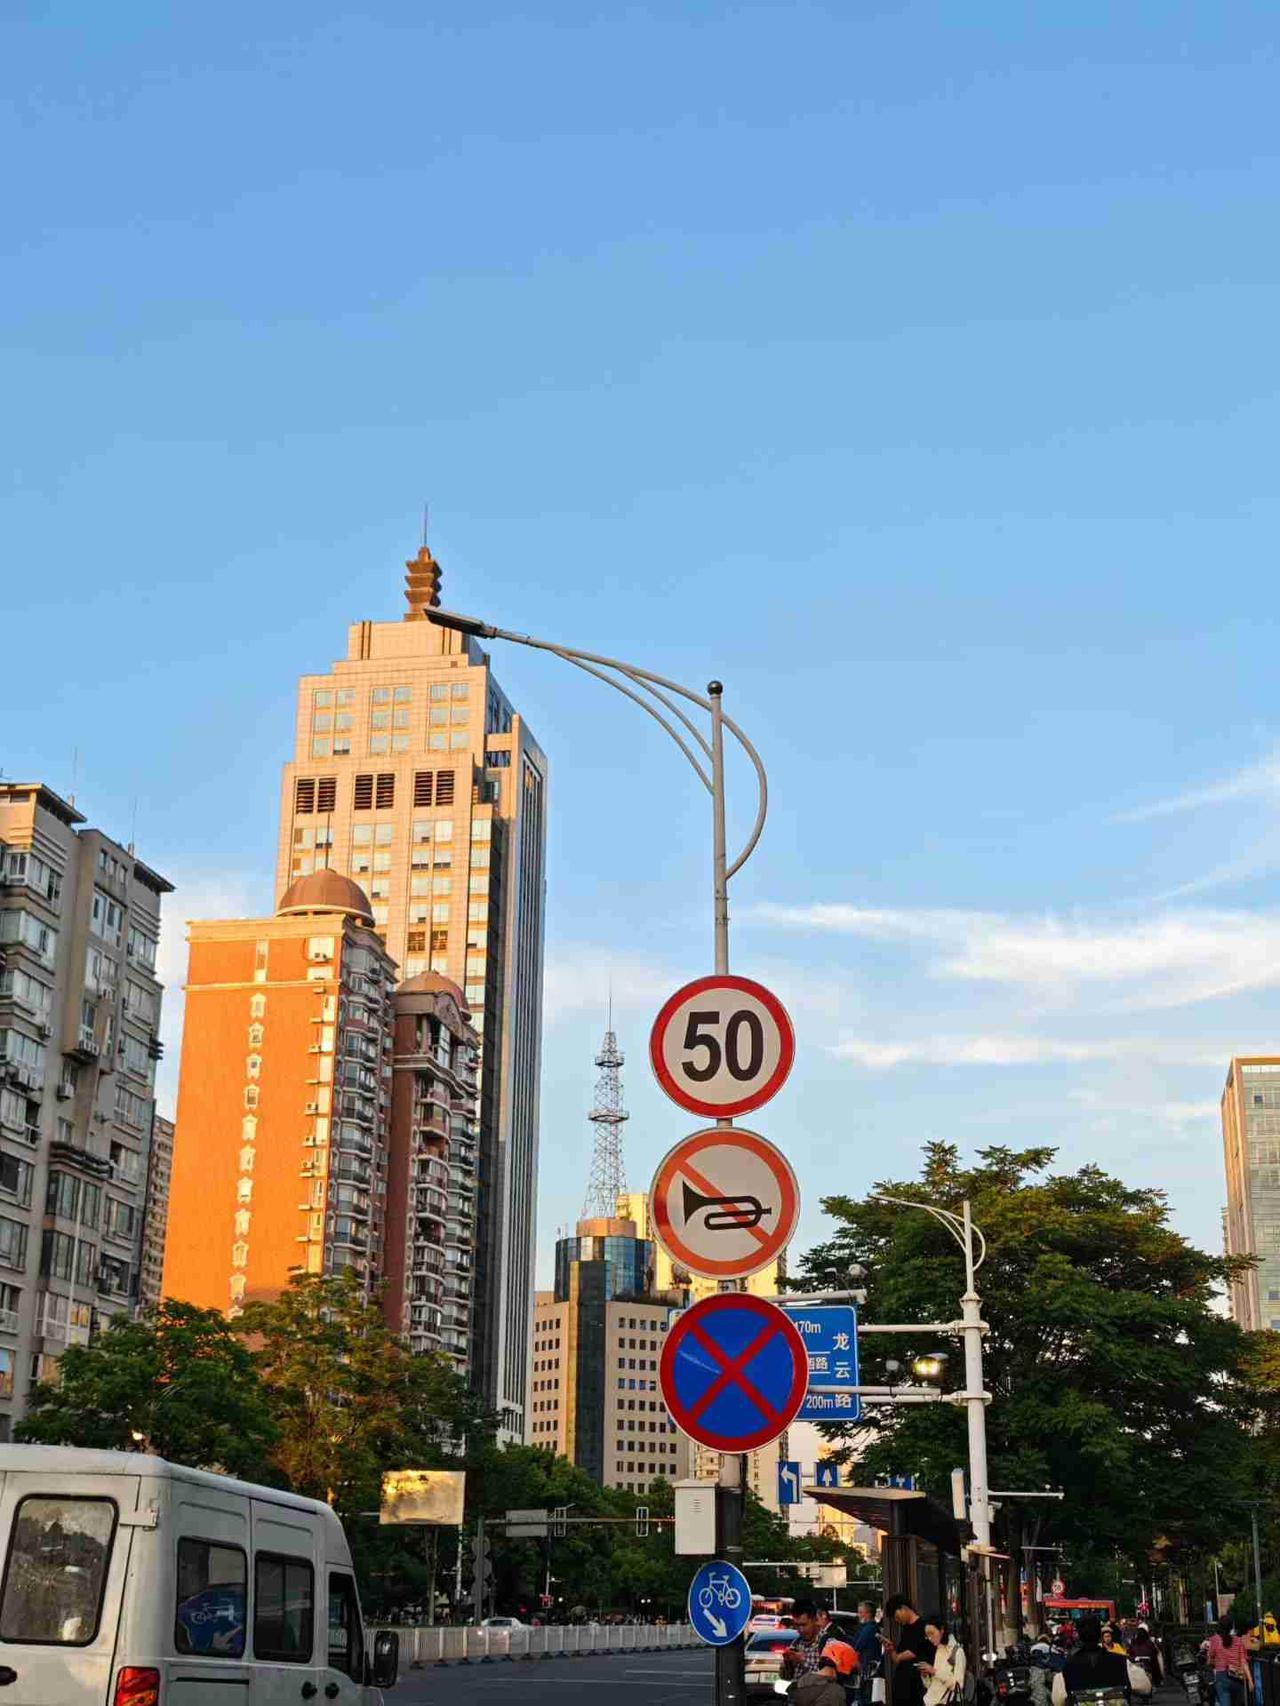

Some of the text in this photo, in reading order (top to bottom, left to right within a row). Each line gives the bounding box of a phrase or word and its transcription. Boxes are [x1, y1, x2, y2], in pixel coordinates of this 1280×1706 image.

[681, 1009, 764, 1082] 50
[806, 1395, 833, 1409] 200m
[832, 1332, 852, 1408] 龙云路
